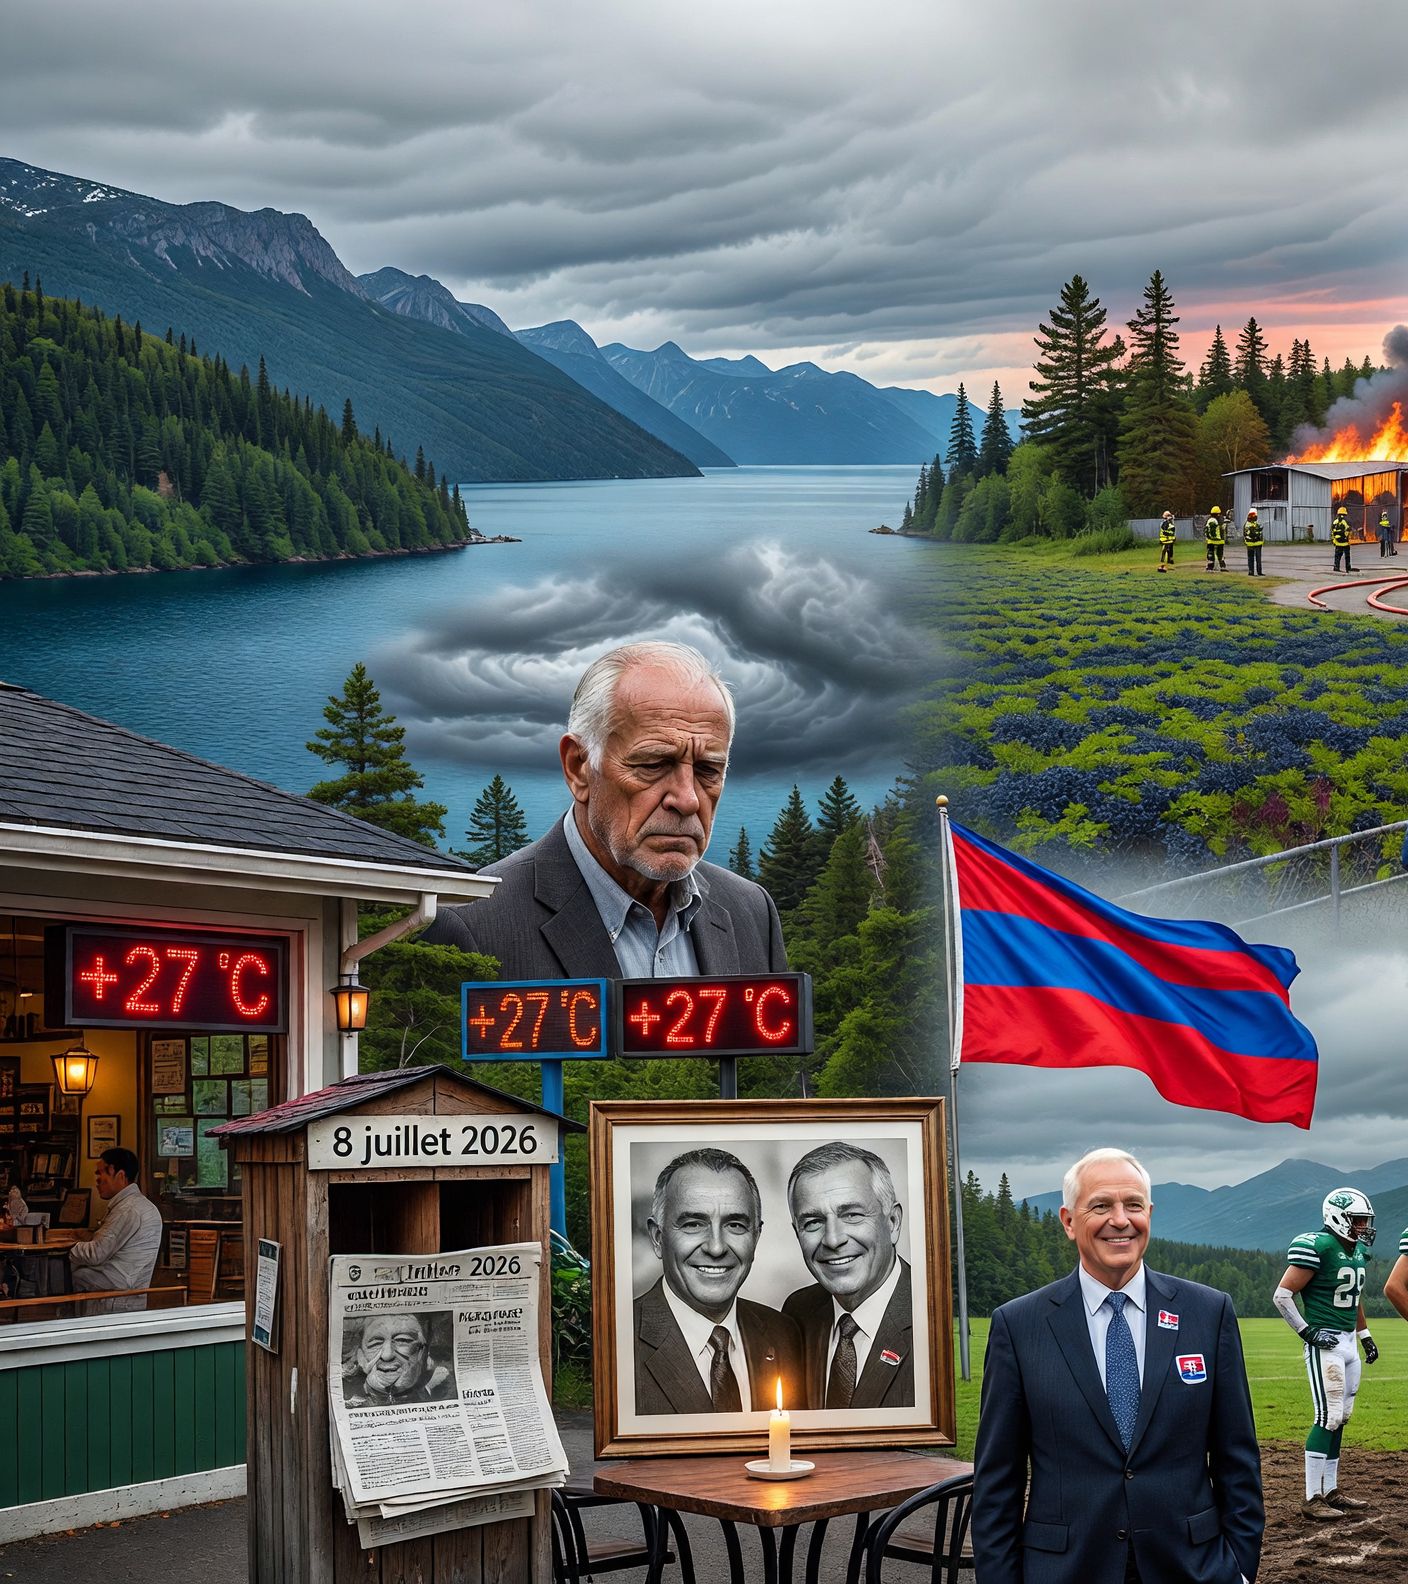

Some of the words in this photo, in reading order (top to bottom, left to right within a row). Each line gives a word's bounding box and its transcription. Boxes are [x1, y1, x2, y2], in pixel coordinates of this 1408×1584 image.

[332, 1126, 353, 1157] 8
[360, 1124, 452, 1165] juillet
[461, 1125, 538, 1155] 2026
[469, 1255, 522, 1277] 2026
